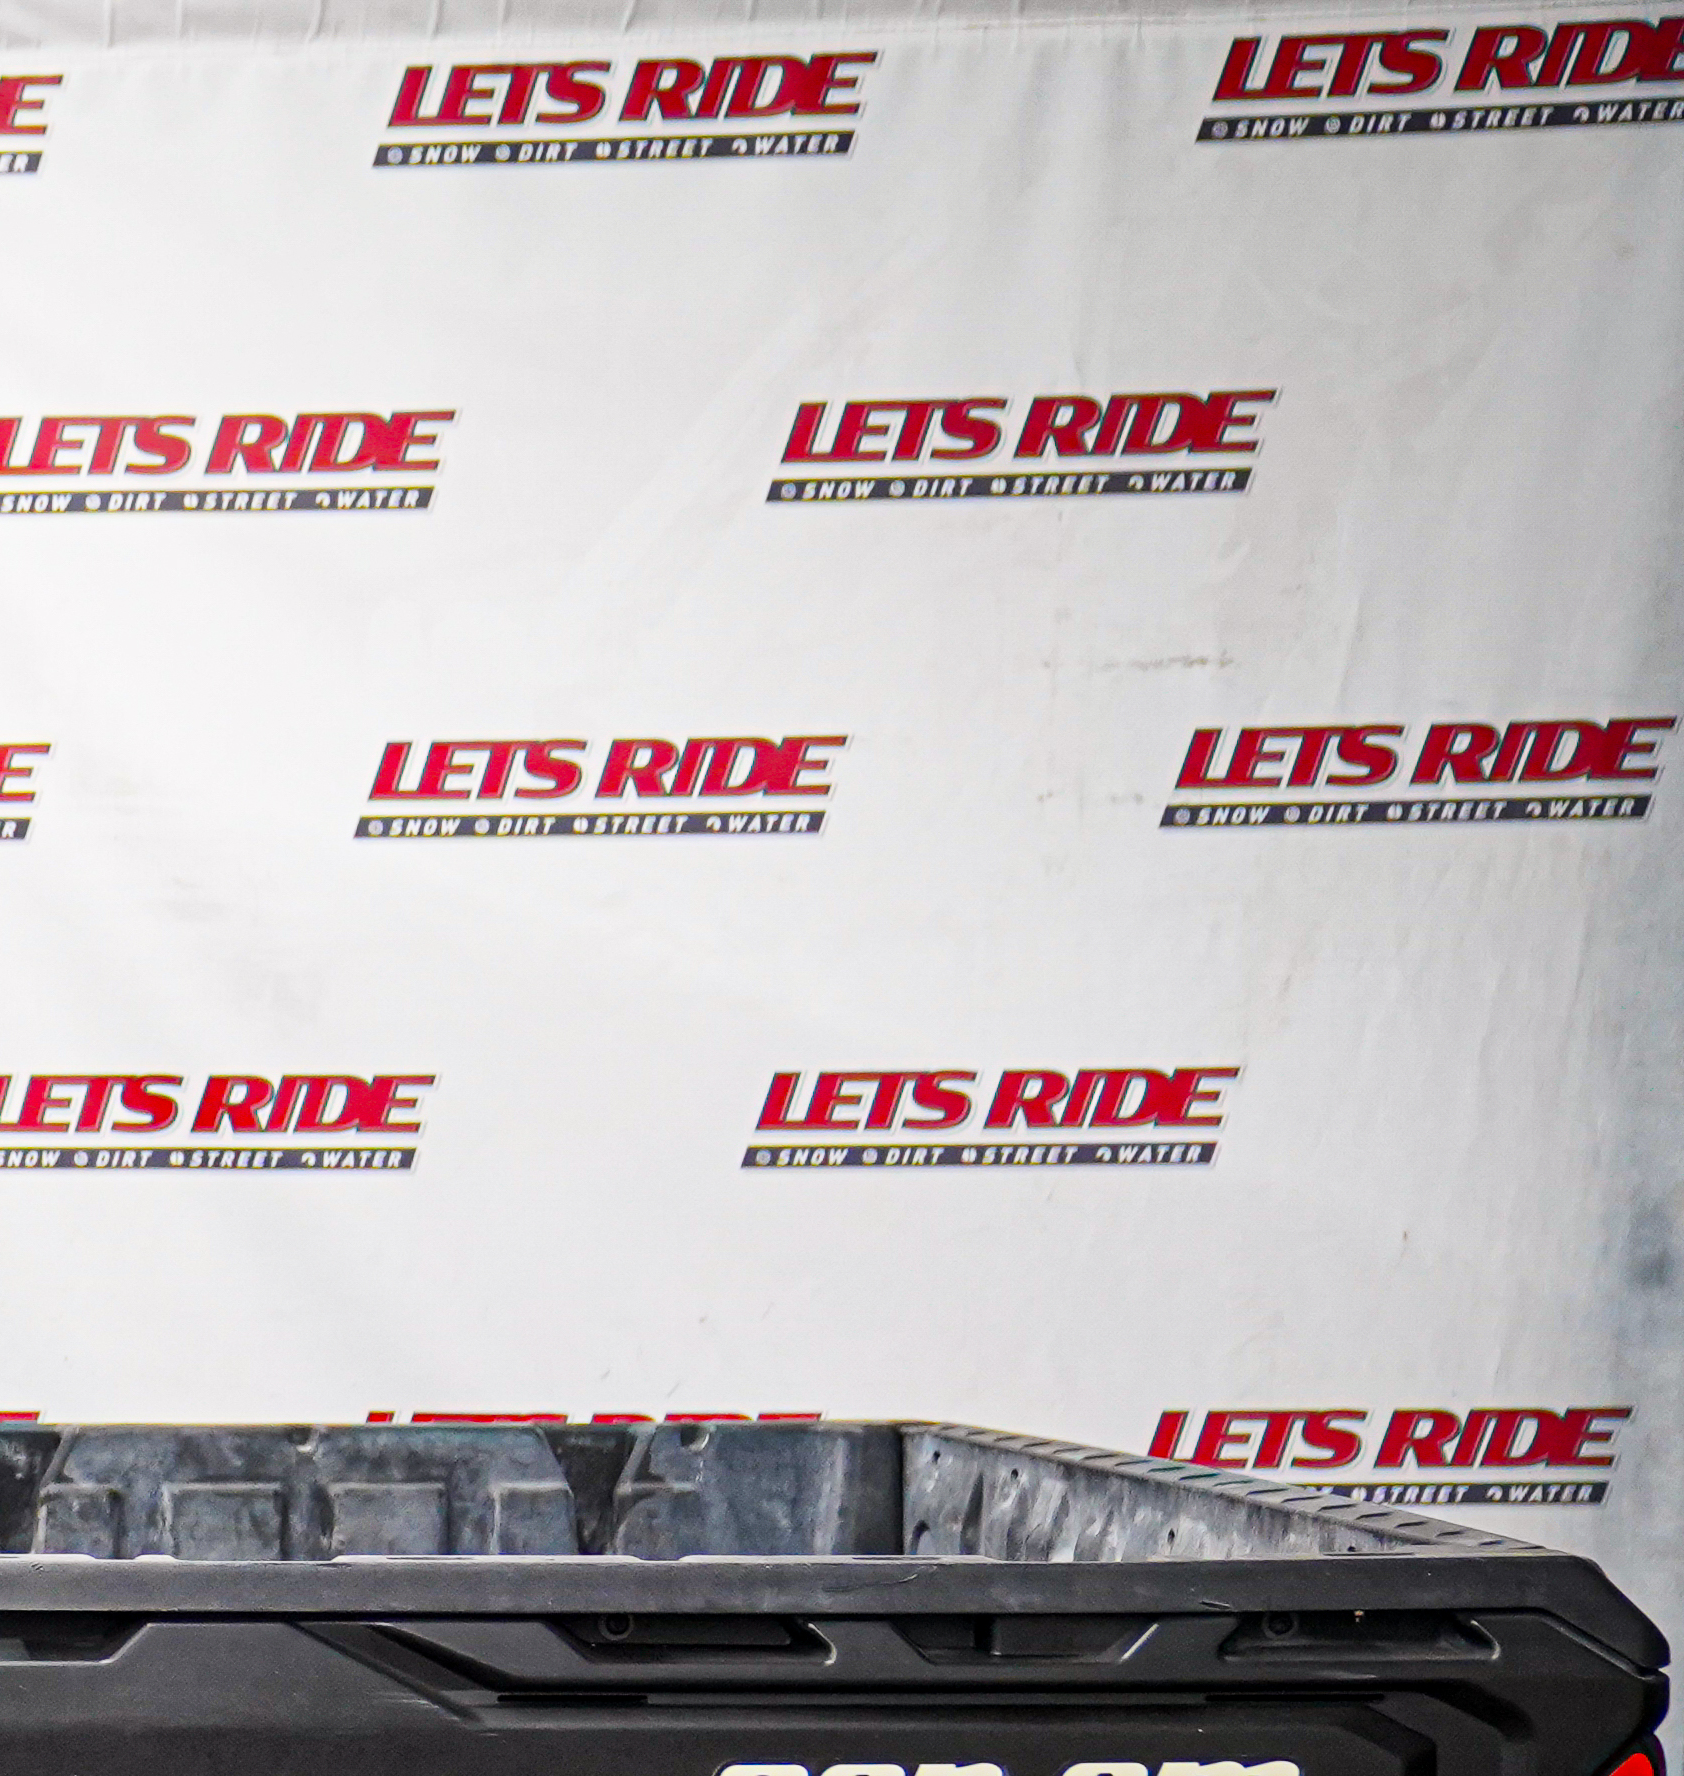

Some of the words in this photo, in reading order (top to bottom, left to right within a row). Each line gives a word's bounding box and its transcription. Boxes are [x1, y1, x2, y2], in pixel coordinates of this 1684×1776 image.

[388, 60, 611, 127] LETS
[619, 52, 878, 121] RIDE
[1212, 28, 1450, 102] LETS
[408, 145, 479, 164] SNOW
[518, 142, 578, 161] DIRT
[616, 139, 715, 159] STREET
[756, 135, 840, 156] WATER
[1235, 117, 1309, 139] SNOW
[1350, 112, 1413, 135] DIRT
[1453, 106, 1555, 131] STREET
[1598, 101, 1684, 126] WATER
[205, 409, 456, 474] RIDE
[781, 397, 1008, 463] LETS
[1014, 389, 1276, 458] RIDE
[1, 496, 70, 512] SNOW
[107, 494, 166, 511] DIRT
[203, 492, 298, 510] STREET
[338, 491, 420, 508] WATER
[802, 481, 874, 500] SNOW
[913, 478, 974, 497] DIRT
[1012, 475, 1111, 495] STREET
[1153, 472, 1238, 493] WATER
[368, 738, 587, 801] LETS
[595, 735, 848, 798] RIDE
[1175, 724, 1403, 789] LETS
[1409, 716, 1678, 785] RIDE
[389, 819, 459, 836] SNOW
[496, 817, 556, 835] DIRT
[593, 816, 689, 834] STREET
[729, 814, 811, 832] WATER
[1196, 806, 1269, 825] SNOW
[1308, 804, 1370, 823] DIRT
[1409, 801, 1509, 821] STREET
[1551, 798, 1638, 819] WATER
[191, 1074, 436, 1133] RIDE
[755, 1069, 977, 1131] LETS
[983, 1066, 1240, 1129] RIDE
[96, 1151, 154, 1168] DIRT
[190, 1151, 283, 1168] STREET
[322, 1151, 403, 1168] WATER
[777, 1148, 847, 1166] SNOW
[885, 1147, 945, 1165] DIRT
[982, 1146, 1079, 1165] STREET
[1119, 1145, 1203, 1164] WATER
[1147, 1409, 1368, 1471] LETS
[1374, 1405, 1635, 1470] RIDE
